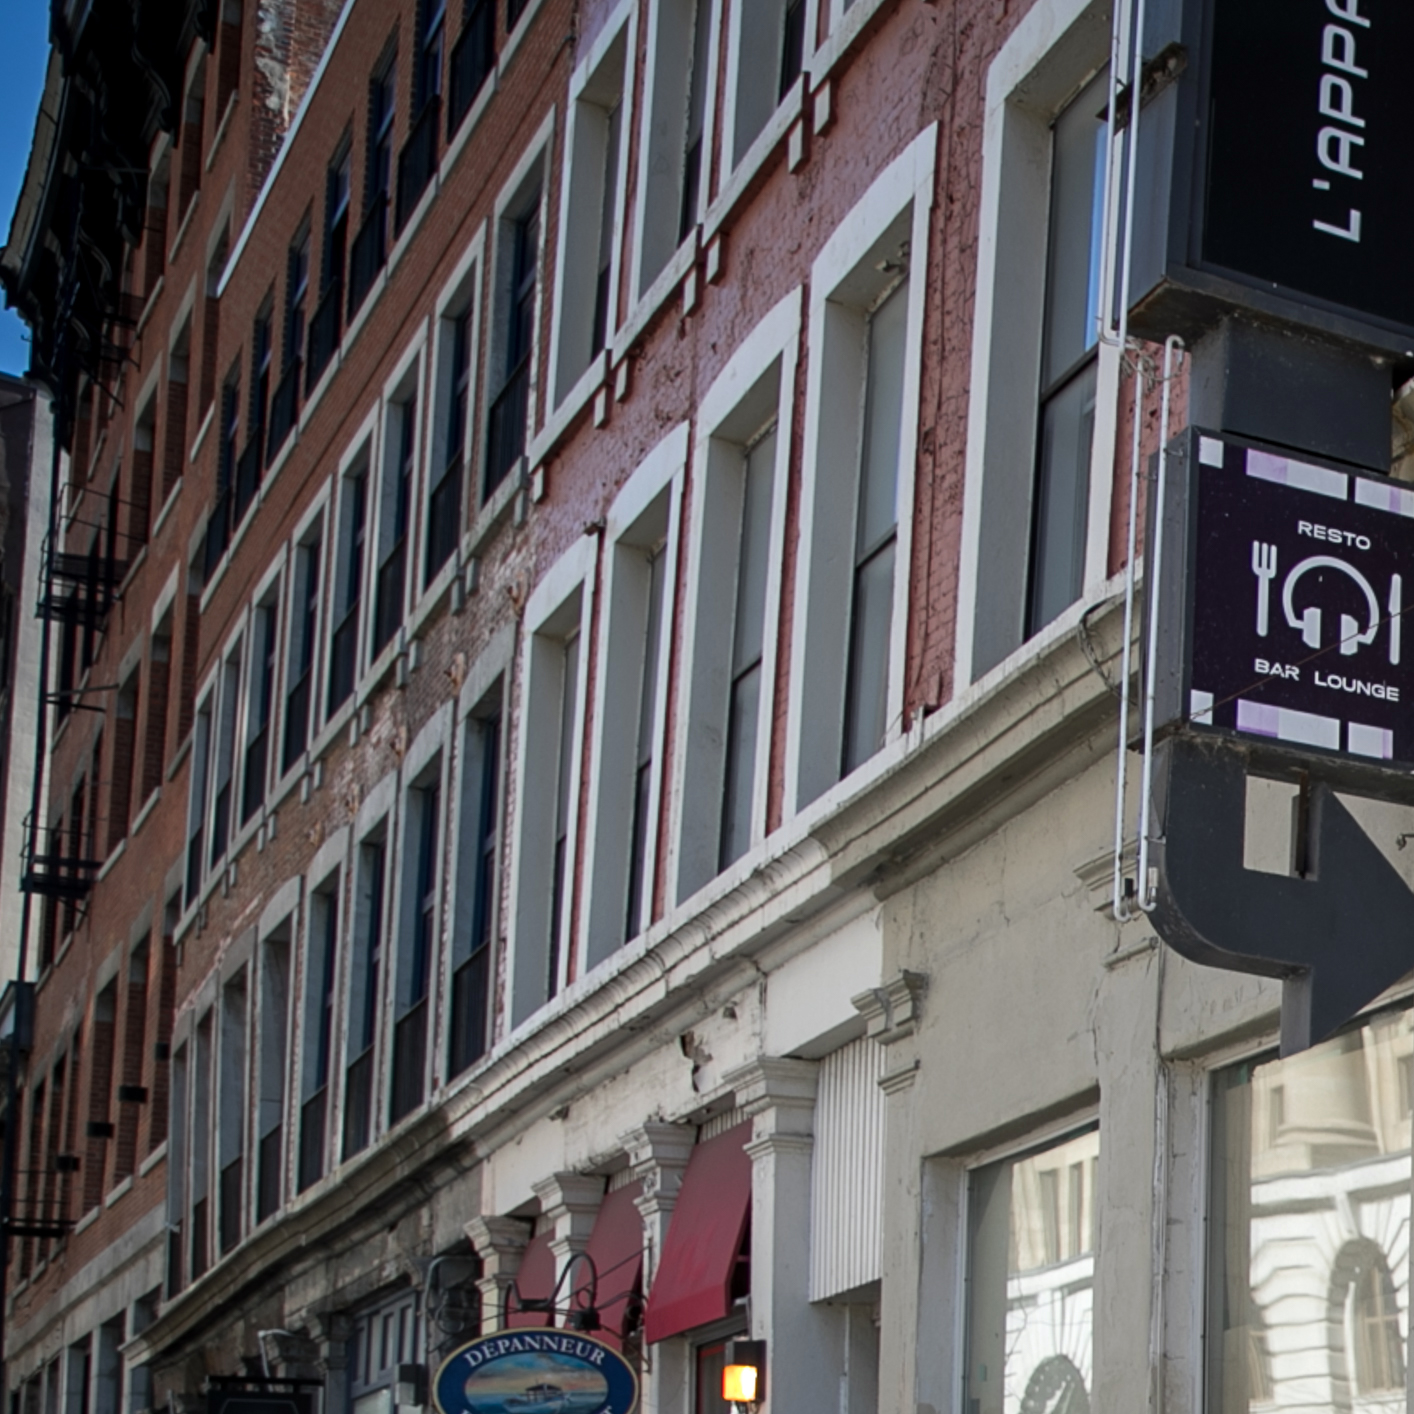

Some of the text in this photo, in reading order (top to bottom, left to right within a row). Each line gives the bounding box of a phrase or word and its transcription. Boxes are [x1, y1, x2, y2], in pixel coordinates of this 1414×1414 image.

[1297, 520, 1372, 550] RESTO
[1254, 658, 1400, 702] BAR LOUNGE
[463, 1335, 606, 1367] DÉPANNEUR
